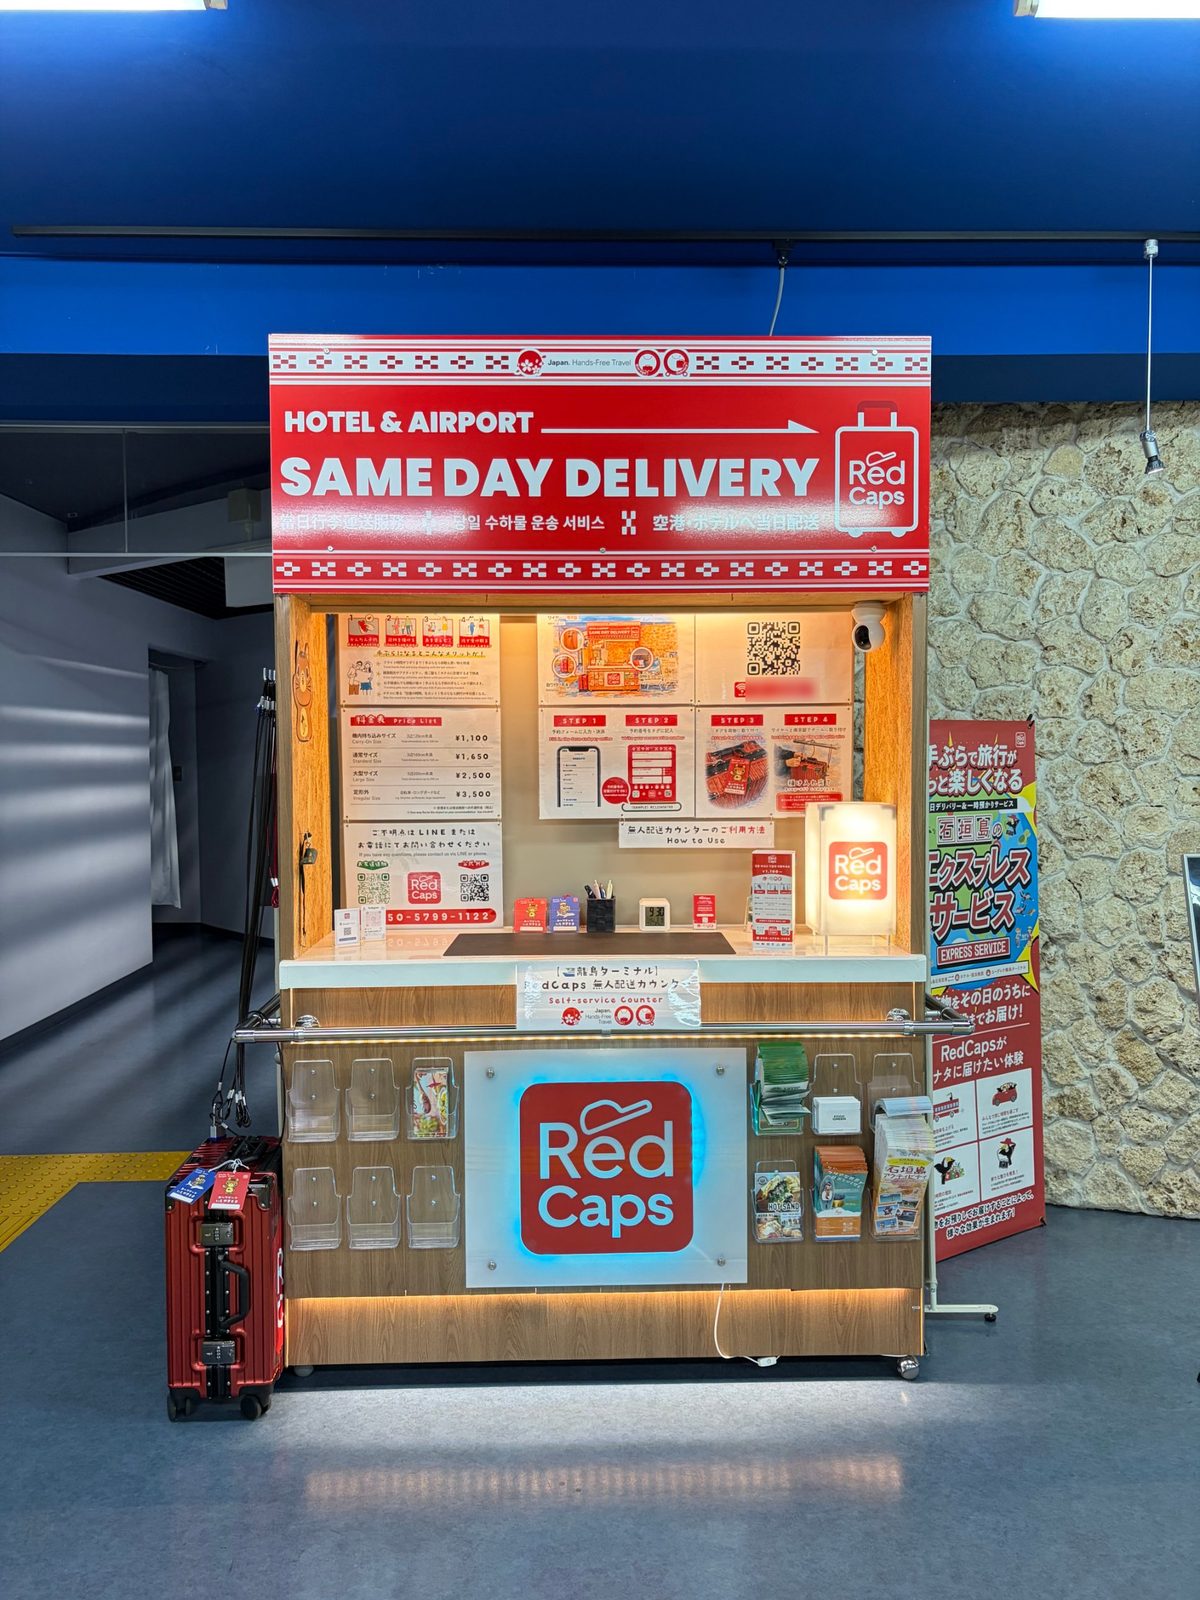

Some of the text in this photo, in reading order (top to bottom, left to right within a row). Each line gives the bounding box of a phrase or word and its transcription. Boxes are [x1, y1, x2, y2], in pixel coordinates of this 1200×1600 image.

[548, 359, 570, 367] Japan.
[284, 410, 534, 433] HOTEL & AIRPORT
[280, 457, 820, 497] SAME DAY DELIVERY
[849, 460, 906, 486] Red
[849, 487, 905, 510] Caps
[485, 515, 527, 531] 수하물
[531, 515, 559, 531] 운송
[563, 515, 605, 531] 서비스
[356, 714, 385, 724] 料金表
[455, 735, 488, 743] ¥1,100
[455, 753, 489, 761] ¥1,650
[929, 744, 1017, 767] 手ぶらで旅行が
[456, 772, 491, 780] ¥2,500
[456, 791, 491, 799] ¥3,500
[628, 826, 766, 834] 無人配送カウンターのご利用方法
[940, 817, 1002, 840] 石垣島の
[358, 841, 490, 849] お電話にてお問い合わせください
[834, 854, 882, 875] Red
[411, 879, 438, 890] Red
[834, 876, 881, 894] Caps
[411, 891, 438, 901] Caps
[929, 889, 1015, 940] サービス
[941, 940, 1007, 961] EXPRESS SERVICE
[620, 996, 664, 1004] Counter
[935, 984, 1031, 1009] 物をその日のうちに
[941, 1036, 1007, 1062] RedCapsが
[933, 1051, 1024, 1084] ナタに届けたい体験
[539, 1120, 674, 1179] Red
[887, 1166, 926, 1174] 石垣島
[538, 1185, 674, 1238] Caps
[946, 1207, 1016, 1240] 様々な効果が生まれます!
